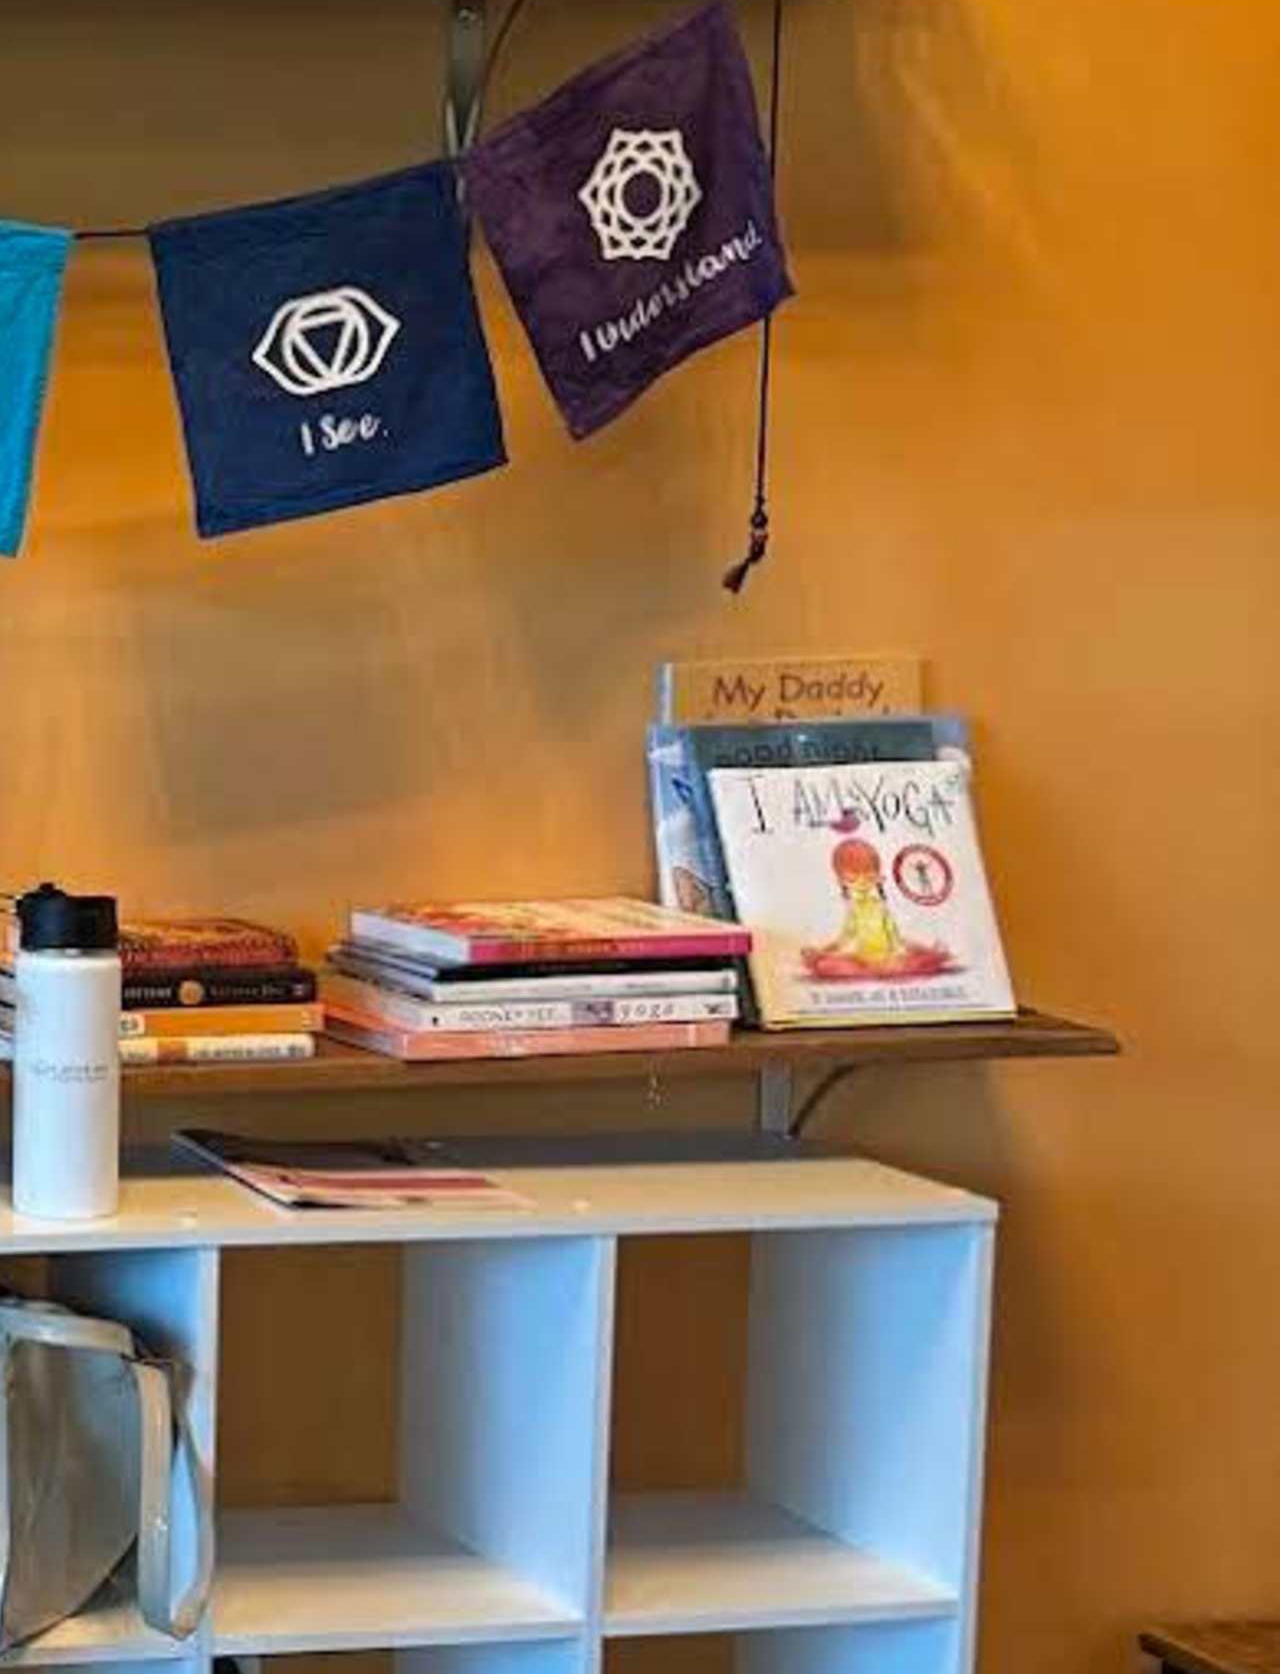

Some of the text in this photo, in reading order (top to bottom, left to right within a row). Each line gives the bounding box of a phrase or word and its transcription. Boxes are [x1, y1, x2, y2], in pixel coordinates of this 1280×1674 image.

[578, 329, 596, 361] I
[300, 422, 314, 455] I
[713, 672, 884, 710] My Daddy
